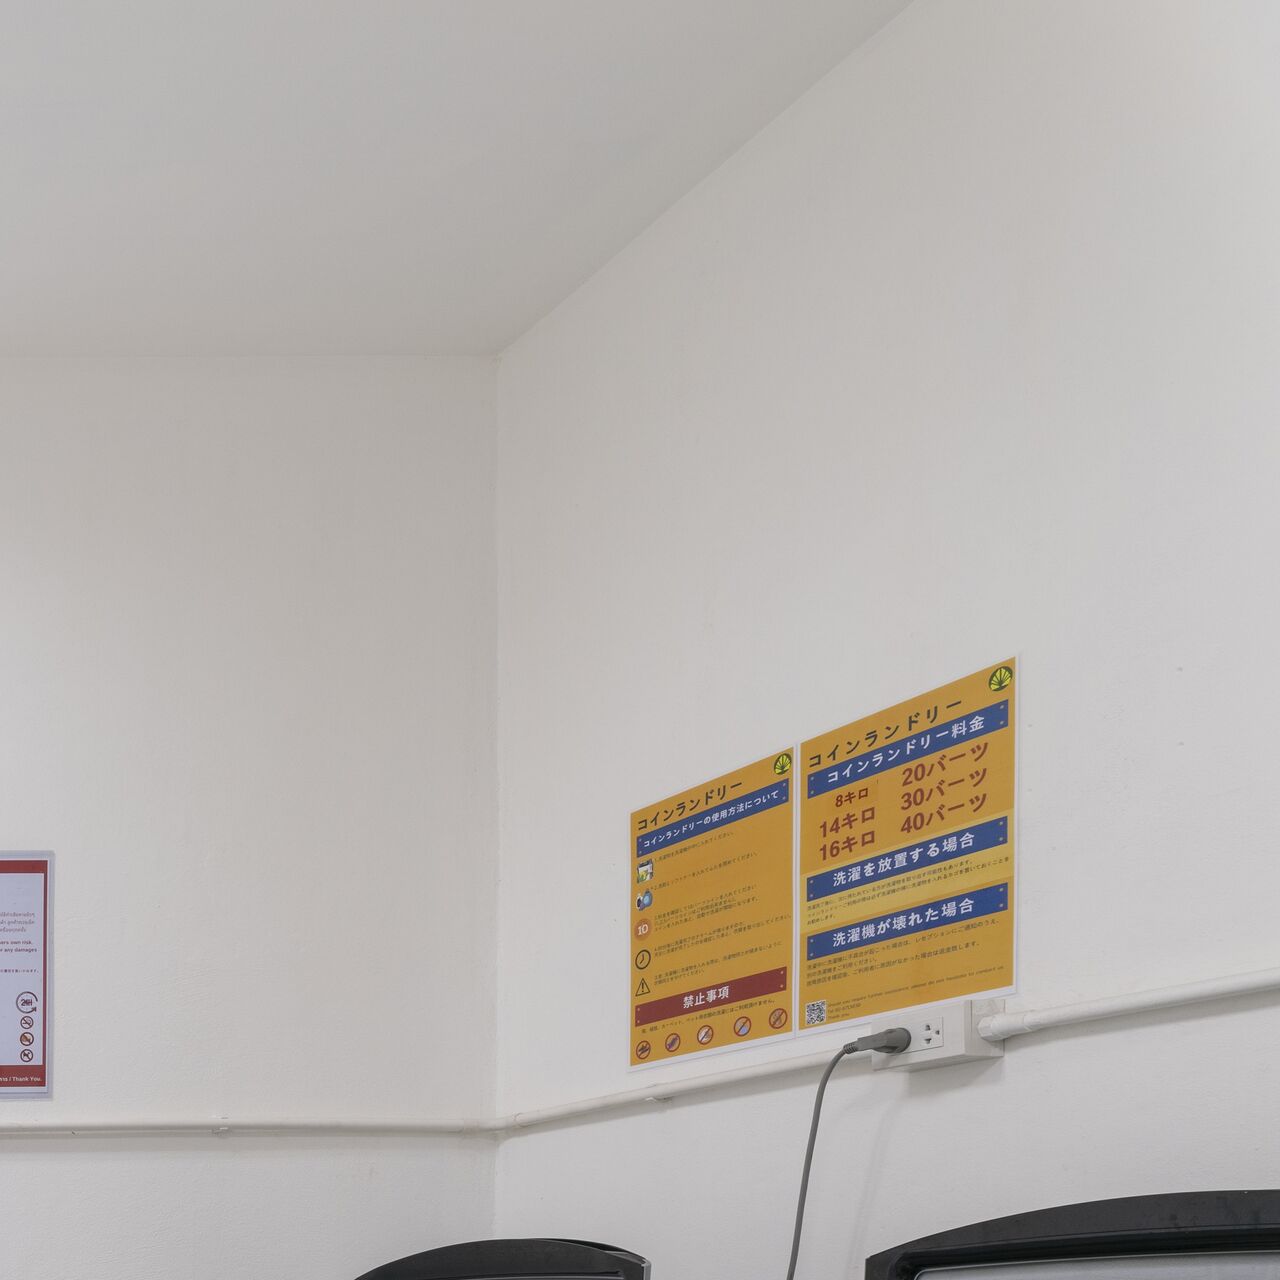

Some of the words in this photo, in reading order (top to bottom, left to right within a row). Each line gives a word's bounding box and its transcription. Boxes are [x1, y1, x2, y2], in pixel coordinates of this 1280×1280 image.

[809, 700, 962, 768] コインランドリー
[827, 715, 985, 784] コインランドリー料金
[820, 807, 875, 838] 14キロ
[901, 768, 987, 810] 30バーツ
[835, 788, 869, 808] 8キロ
[902, 742, 989, 786] 20バーツ
[638, 782, 742, 831] コインランドリー
[644, 790, 779, 848] コインランドリーの使用方法について
[820, 831, 875, 860] 16キロ
[901, 793, 987, 834] 40バーツ
[833, 832, 975, 887] 洗濯を放置する場合
[637, 924, 648, 936] 10
[833, 898, 974, 947] 洗濯機が壊れた場合
[683, 986, 729, 1008] 禁止事項
